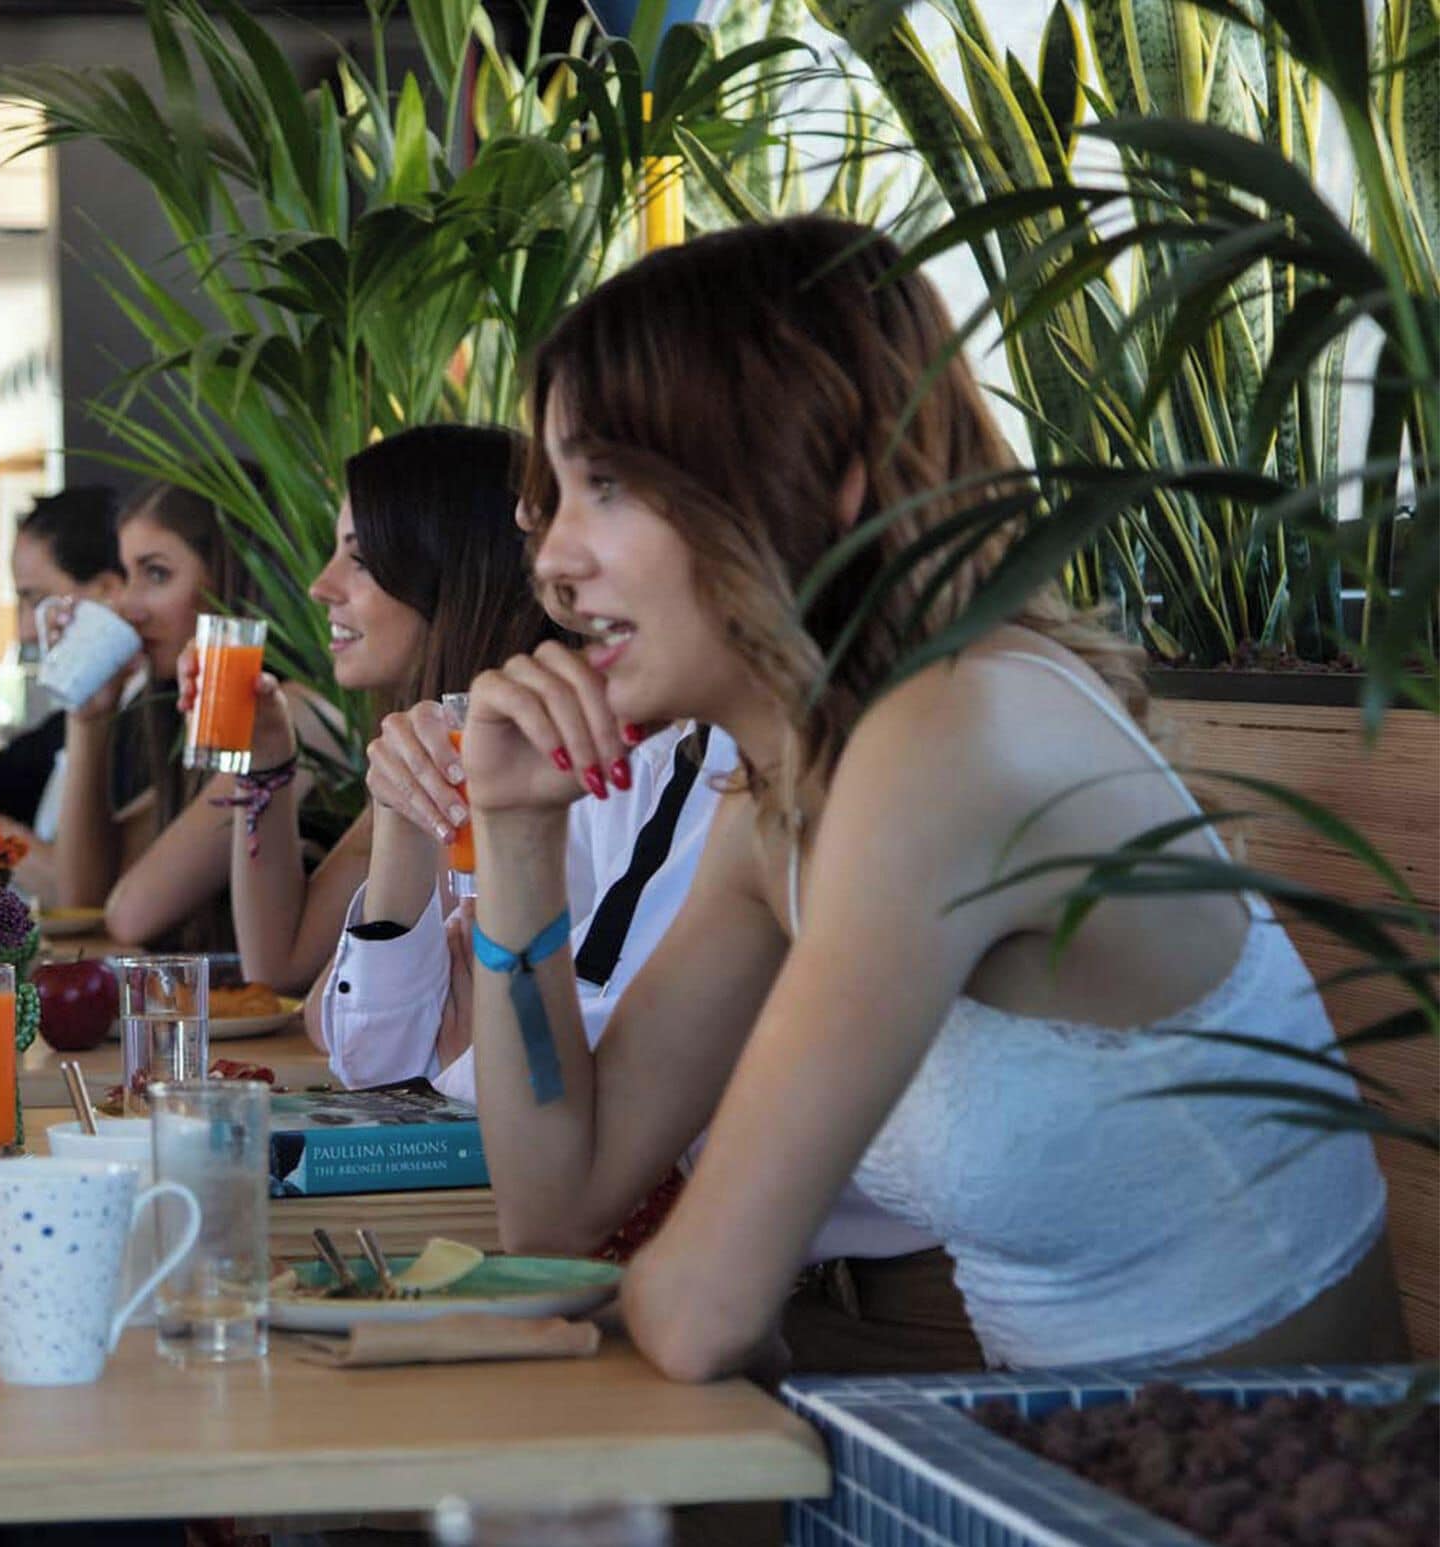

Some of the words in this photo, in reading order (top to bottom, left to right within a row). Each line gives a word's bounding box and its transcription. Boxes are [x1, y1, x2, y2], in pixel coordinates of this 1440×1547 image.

[313, 1144, 384, 1160] PAULLINA
[388, 1139, 448, 1156] SIMONS
[314, 1165, 334, 1177] THE
[340, 1162, 381, 1176] BRONZE
[385, 1158, 447, 1173] HORSEMAN
